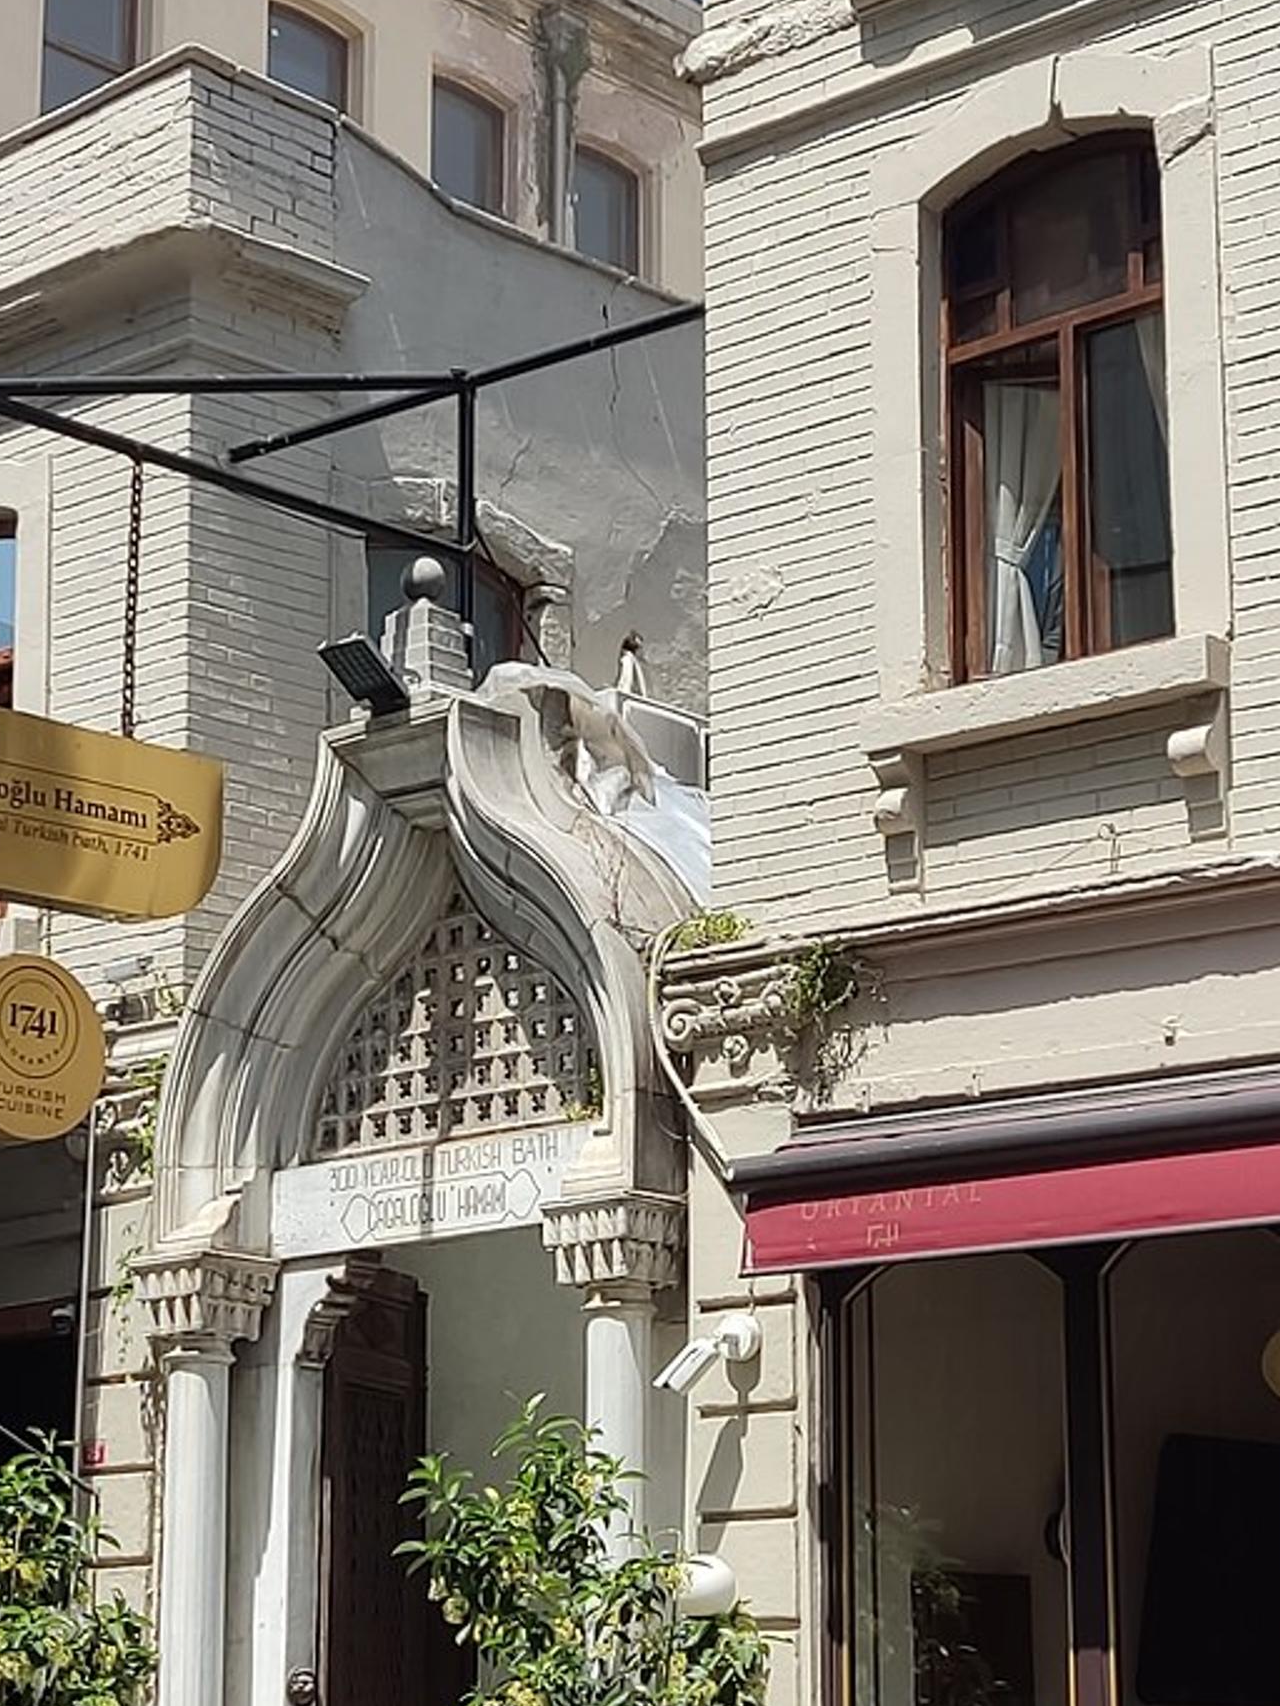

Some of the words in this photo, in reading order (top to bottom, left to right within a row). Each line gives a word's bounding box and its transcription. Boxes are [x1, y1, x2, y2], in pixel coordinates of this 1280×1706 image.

[54, 788, 148, 829] Hamamı
[12, 819, 69, 845] Turkish
[114, 841, 149, 862] 1741
[9, 1002, 57, 1039] 1741
[438, 1143, 502, 1177] TURKISH
[512, 1131, 559, 1165] BATH
